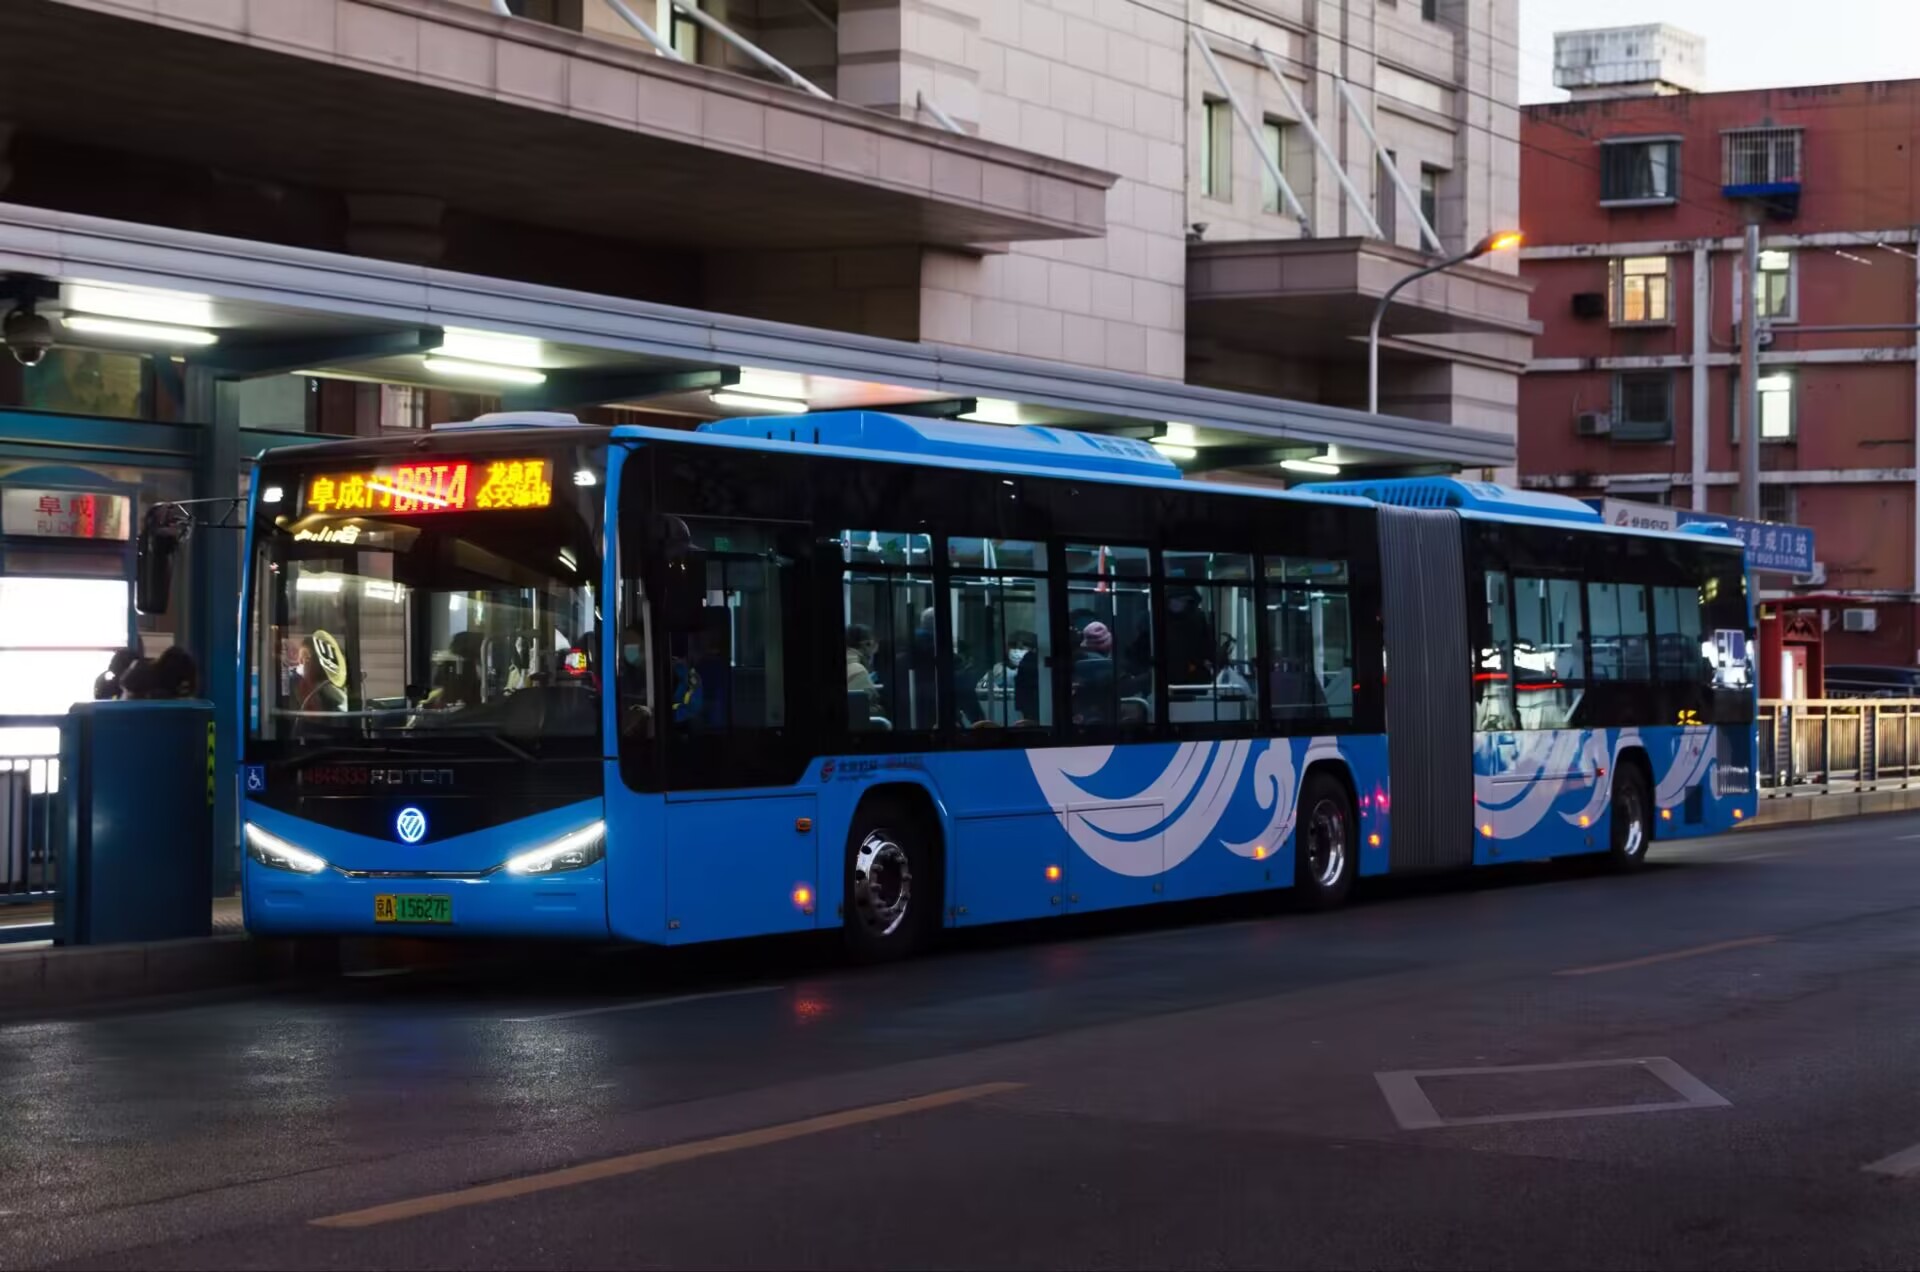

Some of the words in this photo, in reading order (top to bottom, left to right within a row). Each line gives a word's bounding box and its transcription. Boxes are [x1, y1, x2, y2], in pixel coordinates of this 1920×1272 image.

[308, 475, 393, 512] 阜成门
[394, 463, 469, 512] BRT4
[370, 768, 455, 785] FOTON
